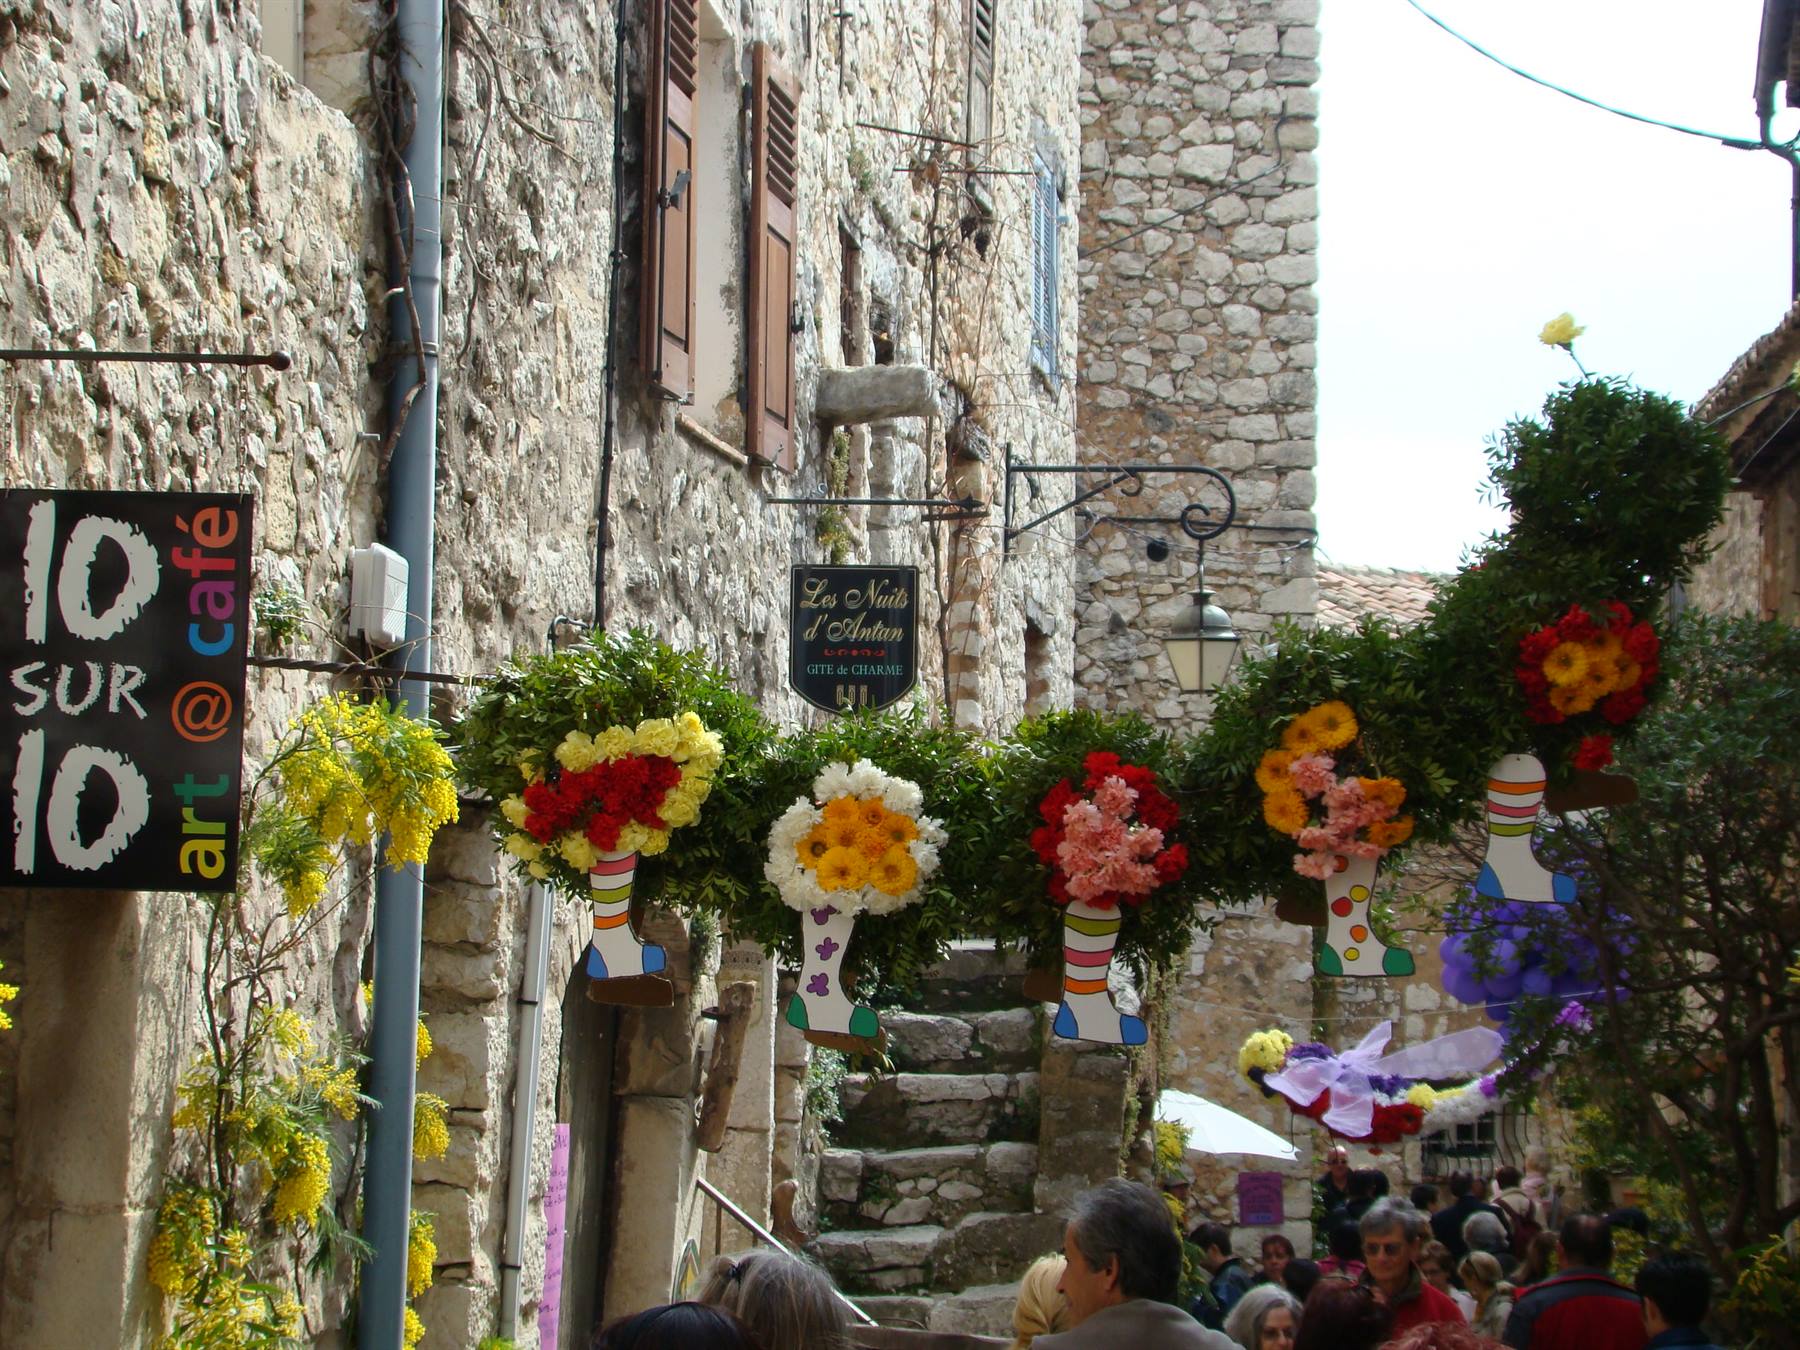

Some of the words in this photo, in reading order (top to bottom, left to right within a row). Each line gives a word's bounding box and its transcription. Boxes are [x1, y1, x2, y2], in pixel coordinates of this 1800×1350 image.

[24, 499, 162, 644] 10
[171, 506, 239, 657] café
[800, 577, 838, 609] Les
[845, 578, 909, 609] Nuits
[803, 611, 905, 642] d'Antan
[10, 661, 148, 720] SUR
[807, 663, 834, 675] GITE
[837, 663, 848, 675] de
[851, 663, 904, 676] CHARME
[171, 681, 233, 743] @
[13, 728, 152, 875] 10
[172, 773, 230, 879] art
